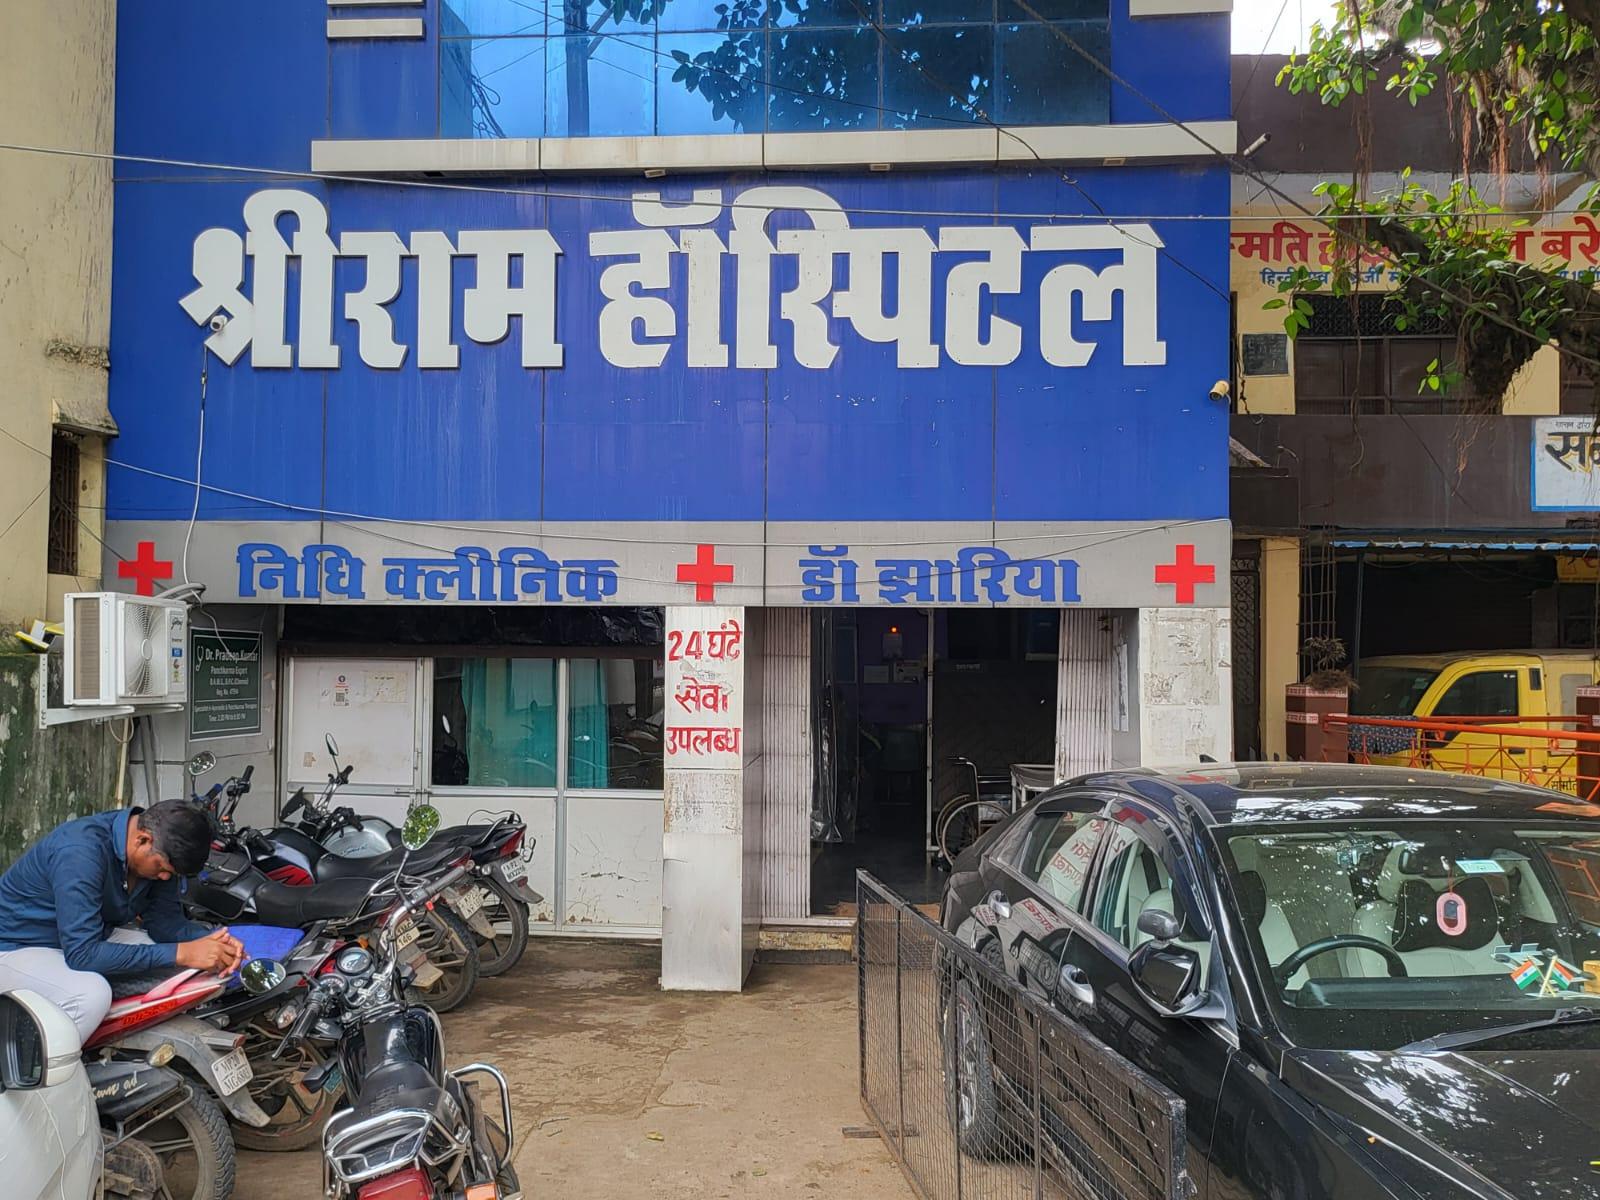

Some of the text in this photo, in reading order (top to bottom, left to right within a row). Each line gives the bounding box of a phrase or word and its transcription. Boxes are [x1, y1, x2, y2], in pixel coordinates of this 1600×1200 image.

[179, 186, 1167, 369] श्रीराम हॉस्पिटल
[236, 543, 621, 602] निधि क्लीनिक
[798, 544, 1082, 603] डॉ झारिया
[667, 619, 742, 662] 24 घंटे
[674, 675, 730, 714] सेवा
[665, 726, 742, 756] उपलब्ध
